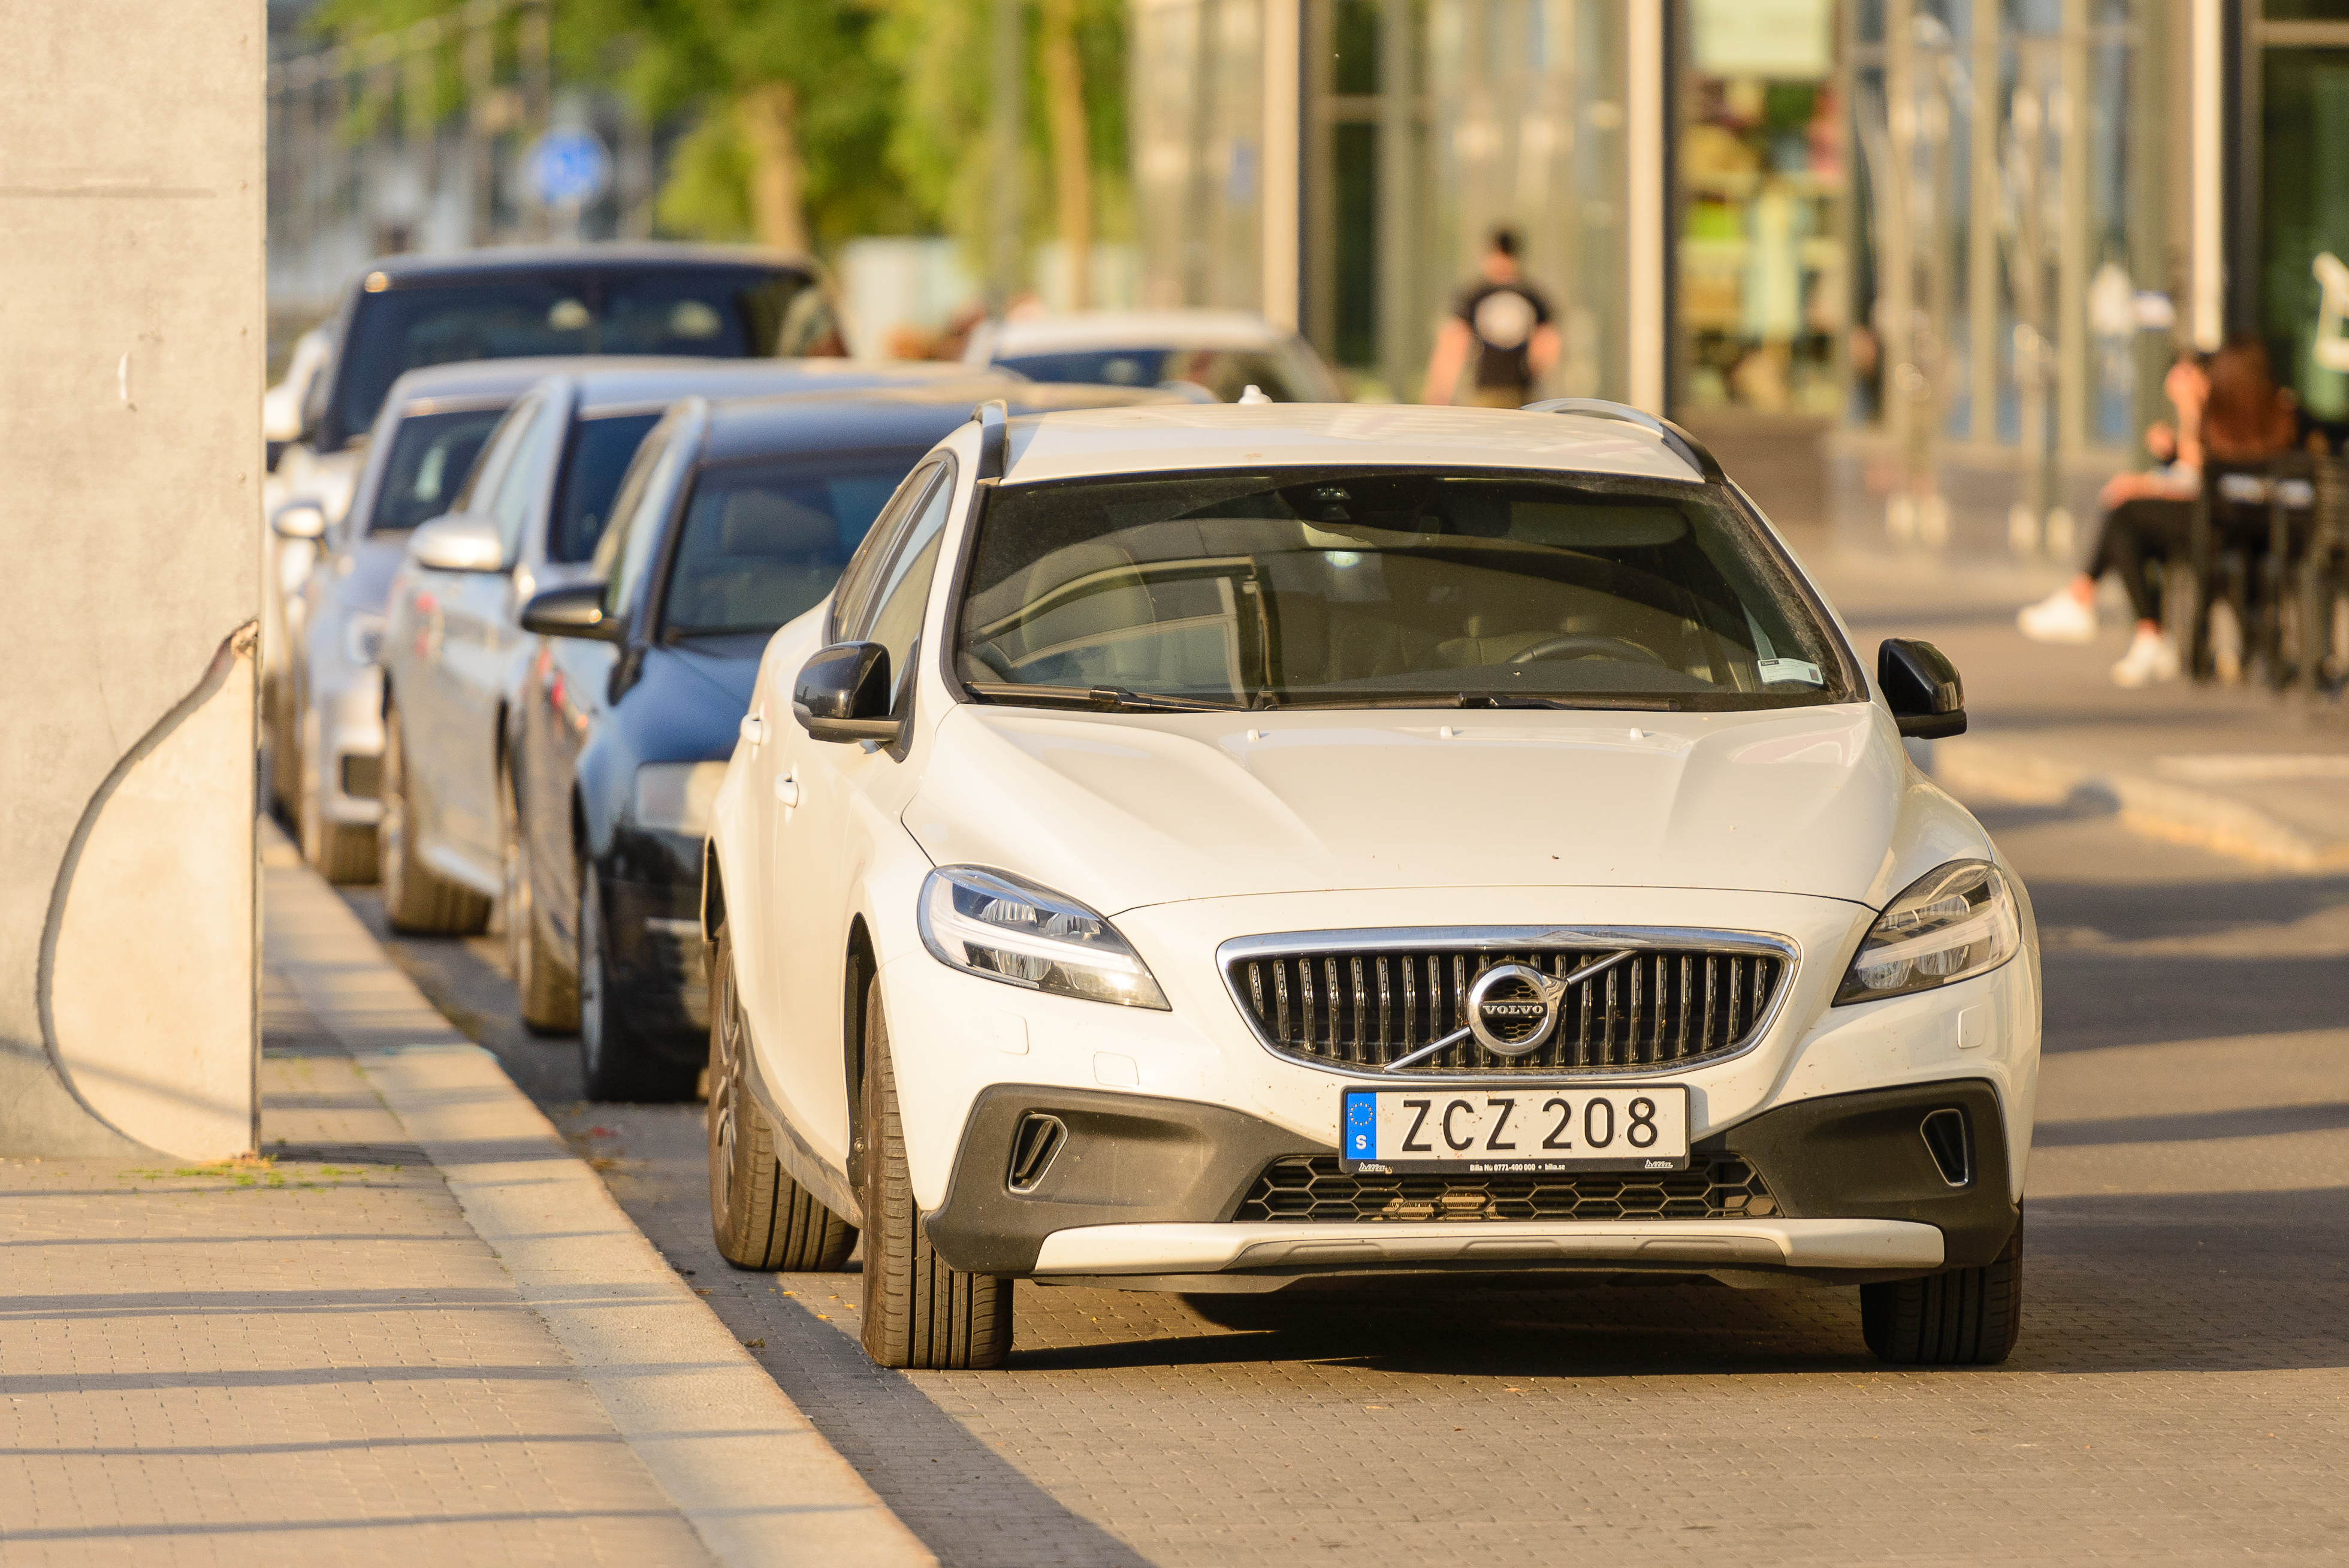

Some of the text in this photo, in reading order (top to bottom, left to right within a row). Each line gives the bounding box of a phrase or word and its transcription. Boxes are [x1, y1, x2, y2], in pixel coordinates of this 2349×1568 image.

[1483, 1005, 1544, 1014] VOLVO
[1402, 1096, 1657, 1152] ZCZ 208
[1355, 1134, 1367, 1150] S
